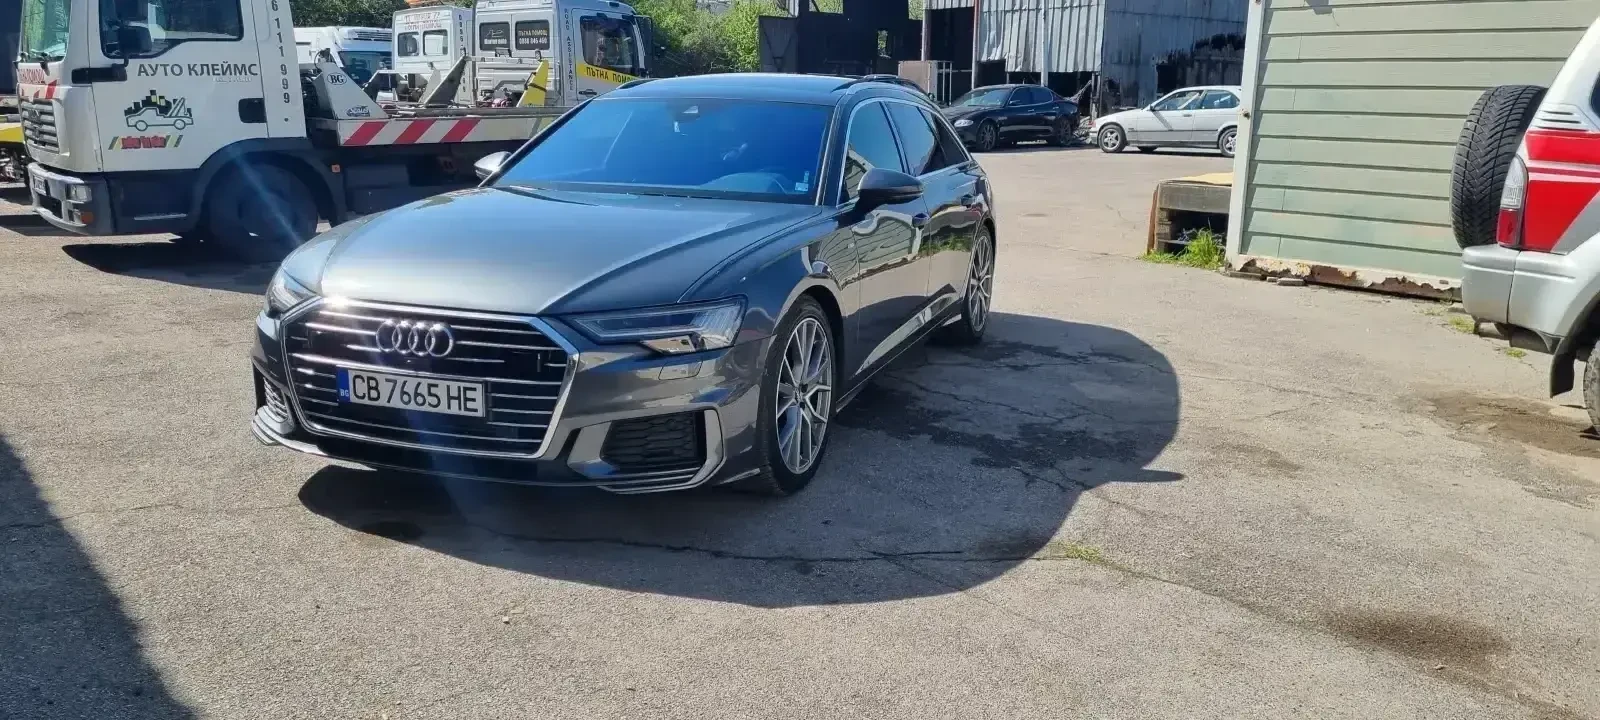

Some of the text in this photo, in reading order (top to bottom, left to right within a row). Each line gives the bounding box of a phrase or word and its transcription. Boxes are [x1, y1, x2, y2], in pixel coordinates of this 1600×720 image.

[137, 61, 258, 77] АУТО КЛЕЙМС
[586, 67, 609, 80] ПЪТНА
[330, 75, 344, 84] BG
[340, 375, 479, 412] BG CB 7665 HE
